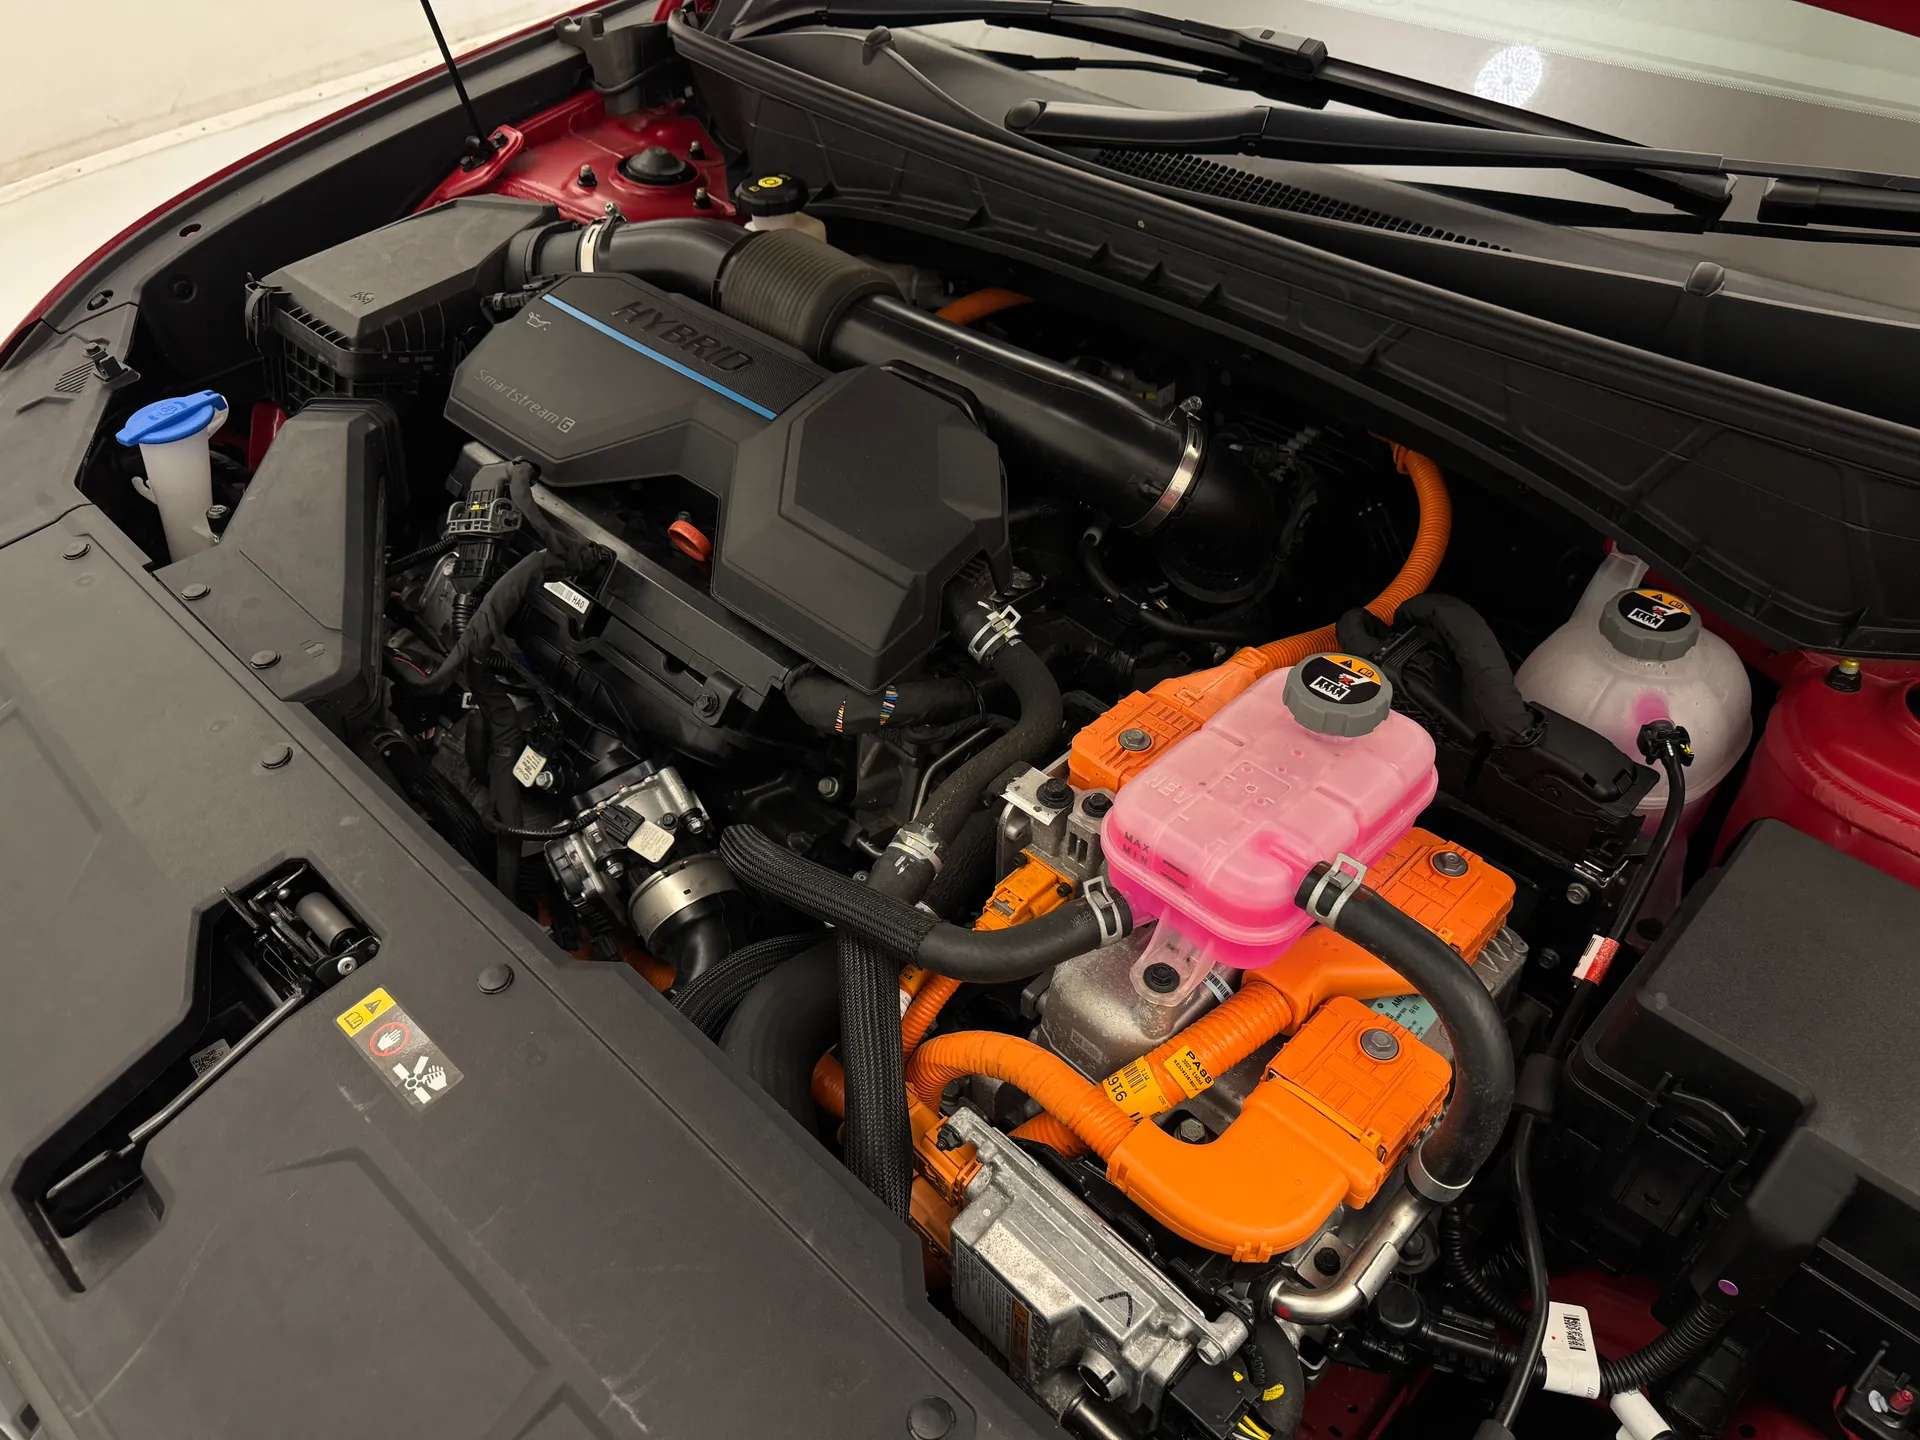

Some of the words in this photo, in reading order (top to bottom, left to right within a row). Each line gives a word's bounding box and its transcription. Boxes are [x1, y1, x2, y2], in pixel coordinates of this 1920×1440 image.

[609, 300, 753, 371] HYBRID
[473, 368, 560, 425] Smartstream
[1124, 831, 1149, 852] MAX
